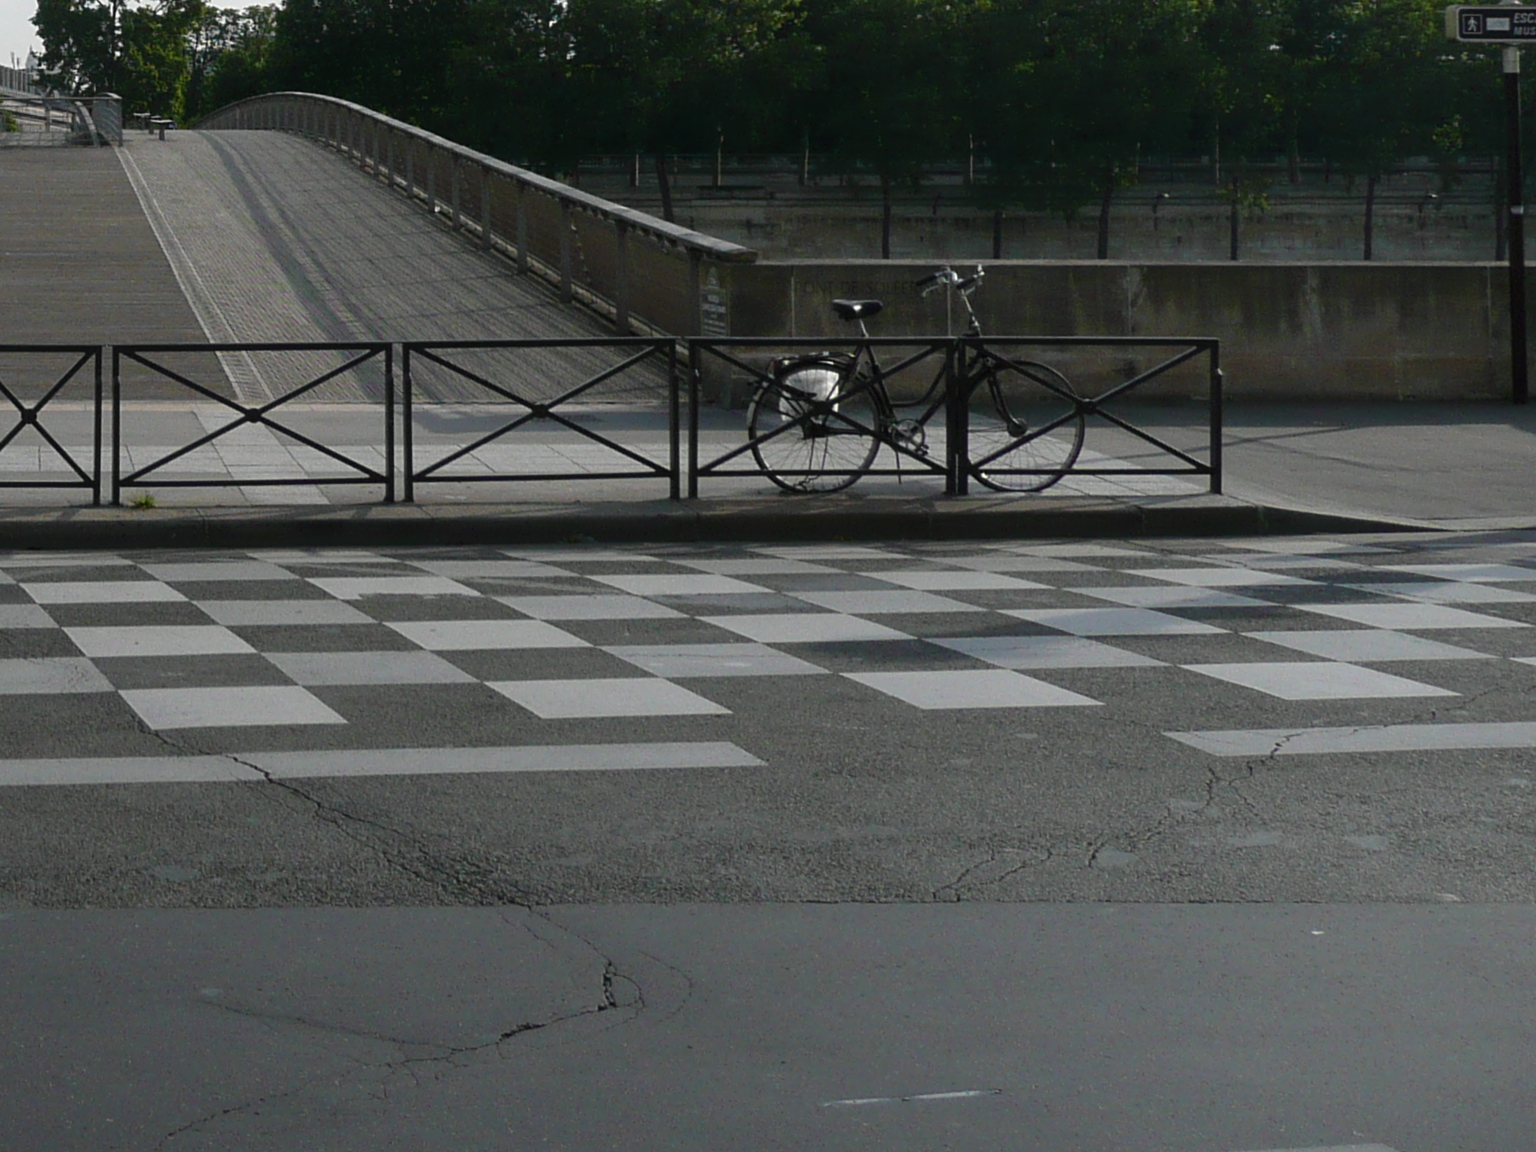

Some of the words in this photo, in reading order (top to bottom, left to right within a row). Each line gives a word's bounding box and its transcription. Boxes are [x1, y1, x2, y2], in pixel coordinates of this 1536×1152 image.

[1513, 12, 1536, 23] ESC
[796, 280, 835, 295] PONT
[840, 280, 859, 295] DE
